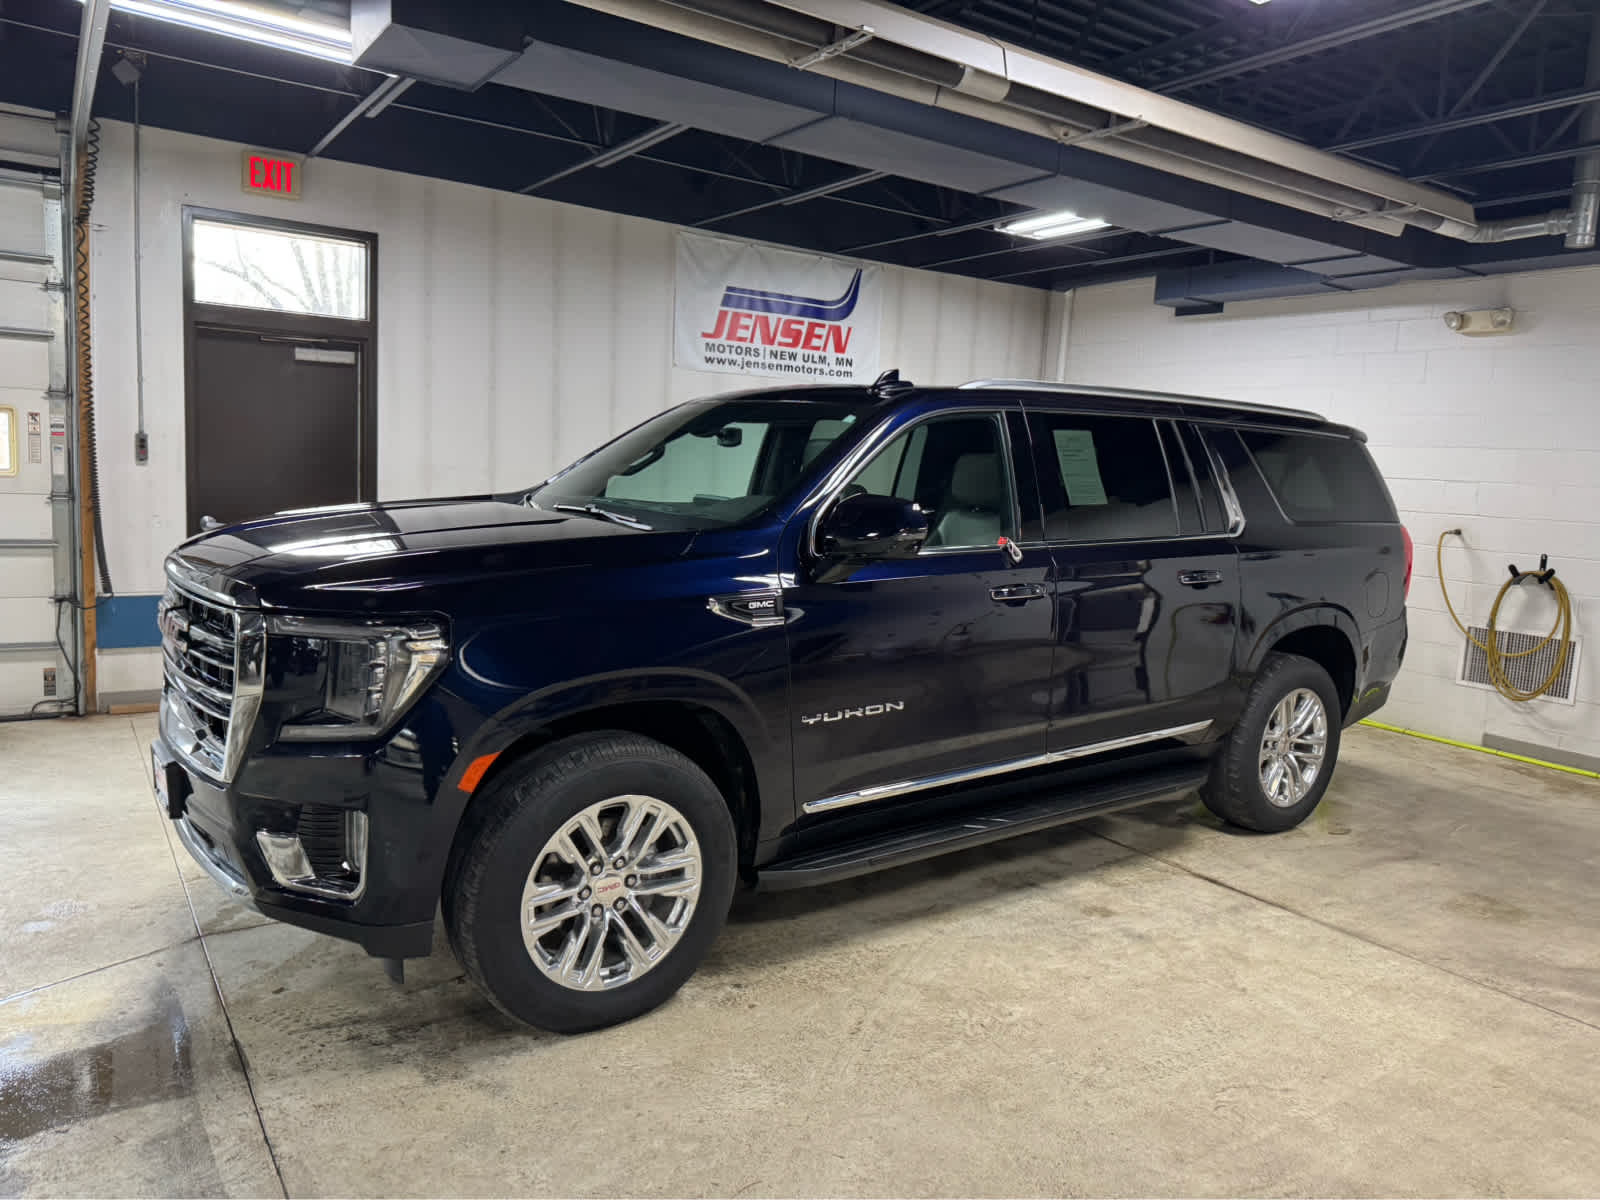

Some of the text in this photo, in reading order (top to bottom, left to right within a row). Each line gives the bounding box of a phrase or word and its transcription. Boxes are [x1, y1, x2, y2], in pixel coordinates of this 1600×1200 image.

[249, 156, 296, 194] EXIT
[701, 309, 853, 355] JENSEN
[704, 342, 853, 368] MOTORS NEW ULM, MN
[704, 355, 853, 378] www.jensenmotors.com
[748, 600, 775, 609] GMC
[801, 701, 904, 725] YUKON
